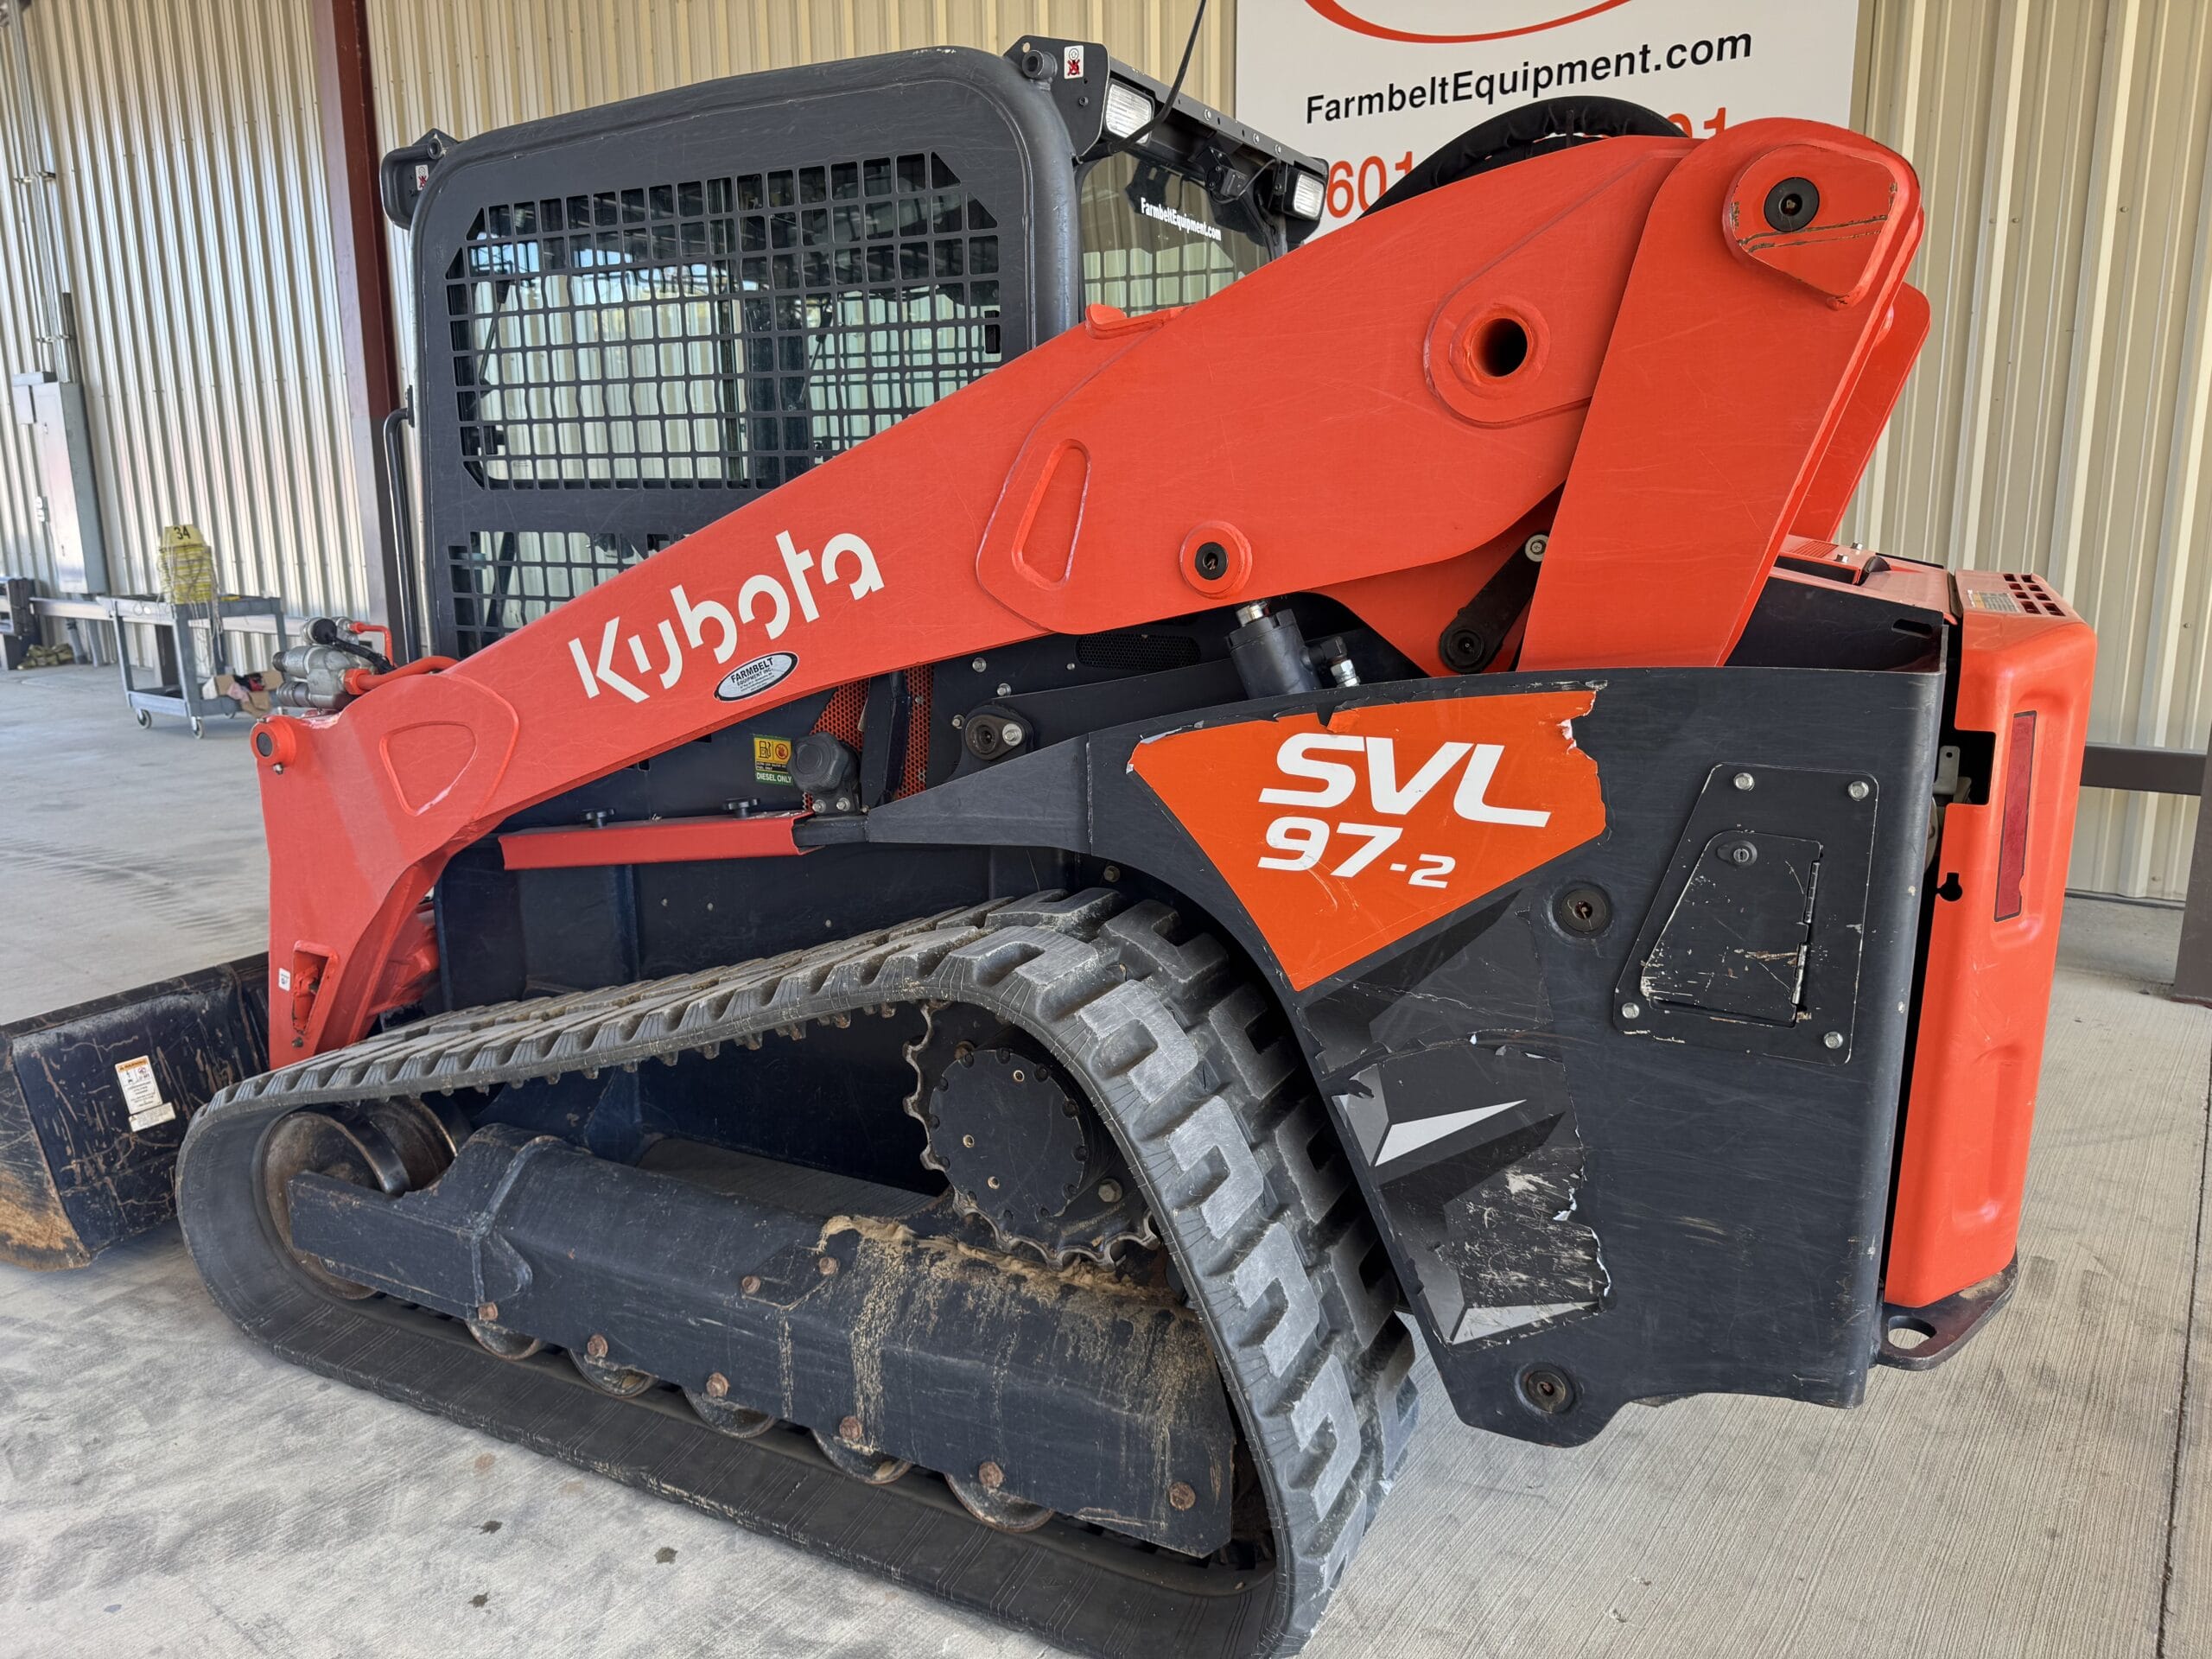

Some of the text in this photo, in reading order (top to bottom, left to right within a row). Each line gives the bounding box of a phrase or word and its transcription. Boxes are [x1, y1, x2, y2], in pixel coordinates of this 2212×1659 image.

[1306, 32, 1752, 124] FarmbeltEquipment.com
[1141, 197, 1222, 241] FarmbeltEquipment.com
[174, 525, 190, 540] 34
[568, 530, 885, 702] Kubota
[730, 657, 773, 683] FARMBELT
[736, 671, 763, 686] EQUIPMENT
[756, 772, 792, 784] DIESEL ONLY
[1258, 732, 1551, 828] SVL
[1257, 816, 1456, 888] 97-2
